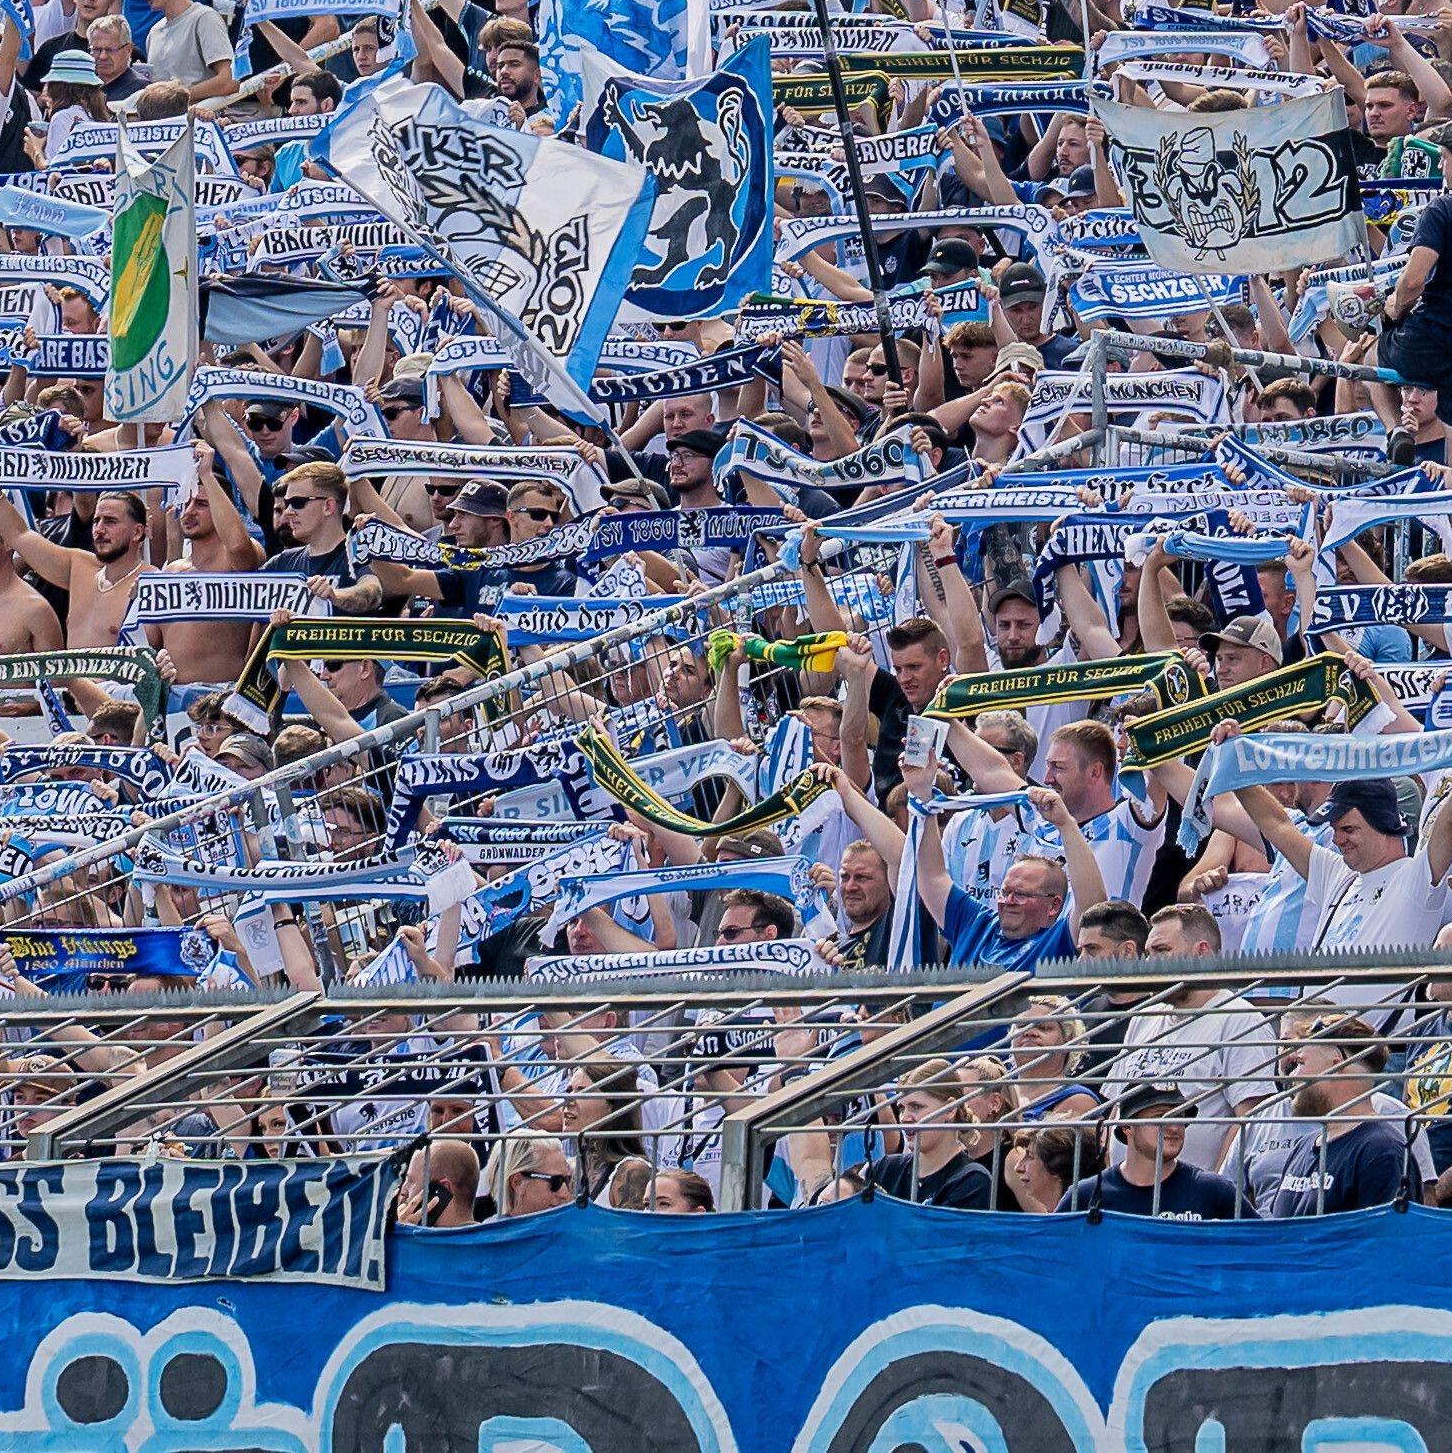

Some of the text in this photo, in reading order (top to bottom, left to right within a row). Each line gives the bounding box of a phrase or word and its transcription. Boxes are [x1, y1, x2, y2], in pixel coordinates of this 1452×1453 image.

[873, 51, 1072, 70] FREIHEIT FÜR SECHZIG
[785, 81, 813, 103] FÜR
[1251, 144, 1347, 238] 12
[264, 232, 316, 256] 1860
[1110, 274, 1228, 303] SECHZGER
[39, 340, 67, 369] ARE
[250, 372, 331, 399] MEISTER
[49, 452, 151, 481] MÜNCHEN
[469, 453, 579, 476] MÜNCHEN
[629, 521, 675, 543] 1860
[139, 581, 313, 614] 860 MÜNCHEN
[522, 604, 615, 633] sind der
[286, 627, 482, 646] FREIHEIT FÜR SECHZIG
[13, 660, 41, 681] EIN
[43, 658, 118, 679] STARKES
[969, 663, 1146, 698] FREIHEIT FÜR SECHZIG
[1155, 677, 1307, 746] FREIHEIT FÜR SECHZIG
[479, 845, 547, 861] GRÜNWALDER
[7, 934, 137, 958] Blue Vikings
[654, 945, 752, 968] MEISTER
[23, 957, 125, 971] 1860 München
[85, 1158, 391, 1285] BLEIBEN!
